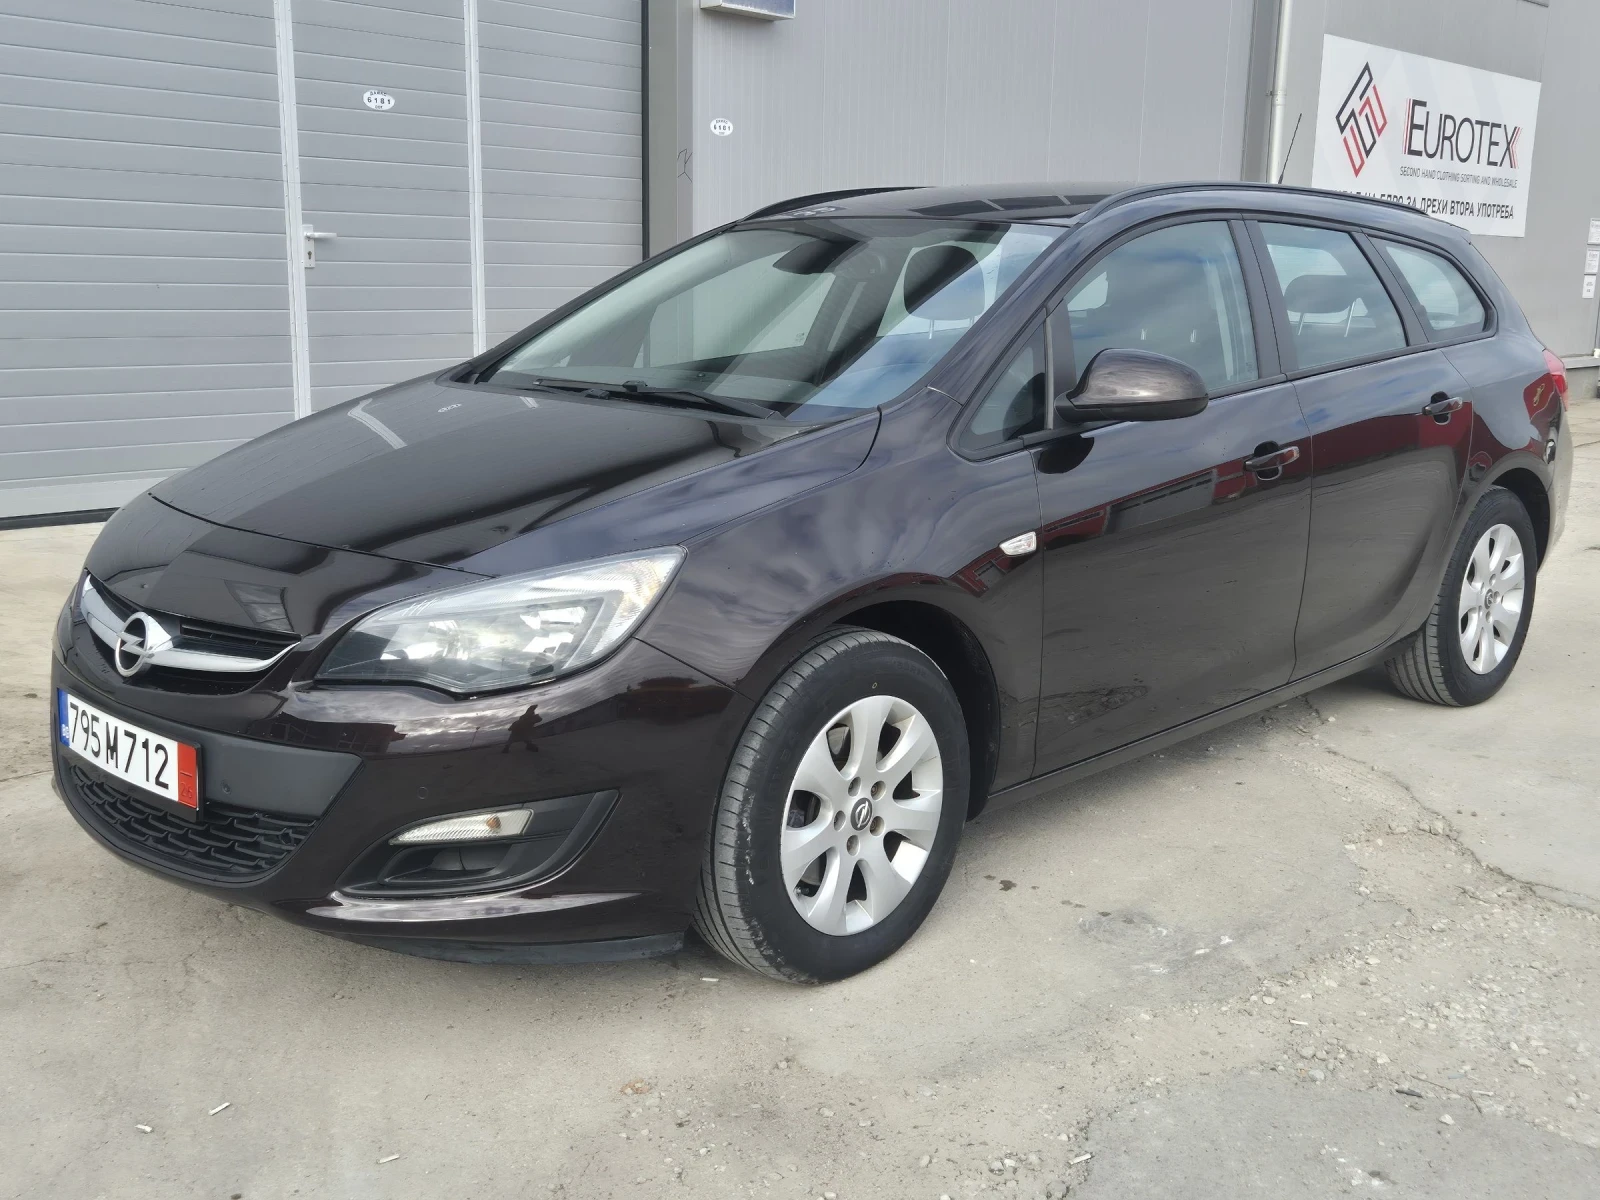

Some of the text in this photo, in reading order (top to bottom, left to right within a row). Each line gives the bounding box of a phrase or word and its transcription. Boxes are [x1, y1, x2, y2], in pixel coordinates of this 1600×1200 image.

[1400, 166, 1518, 188] SECOND HAND CLOTHING SORTING AND WHOLESALE
[1420, 197, 1448, 214] ДРЕХИ
[1450, 200, 1474, 216] ВТОРА
[1476, 203, 1514, 219] УПОТРЕБА
